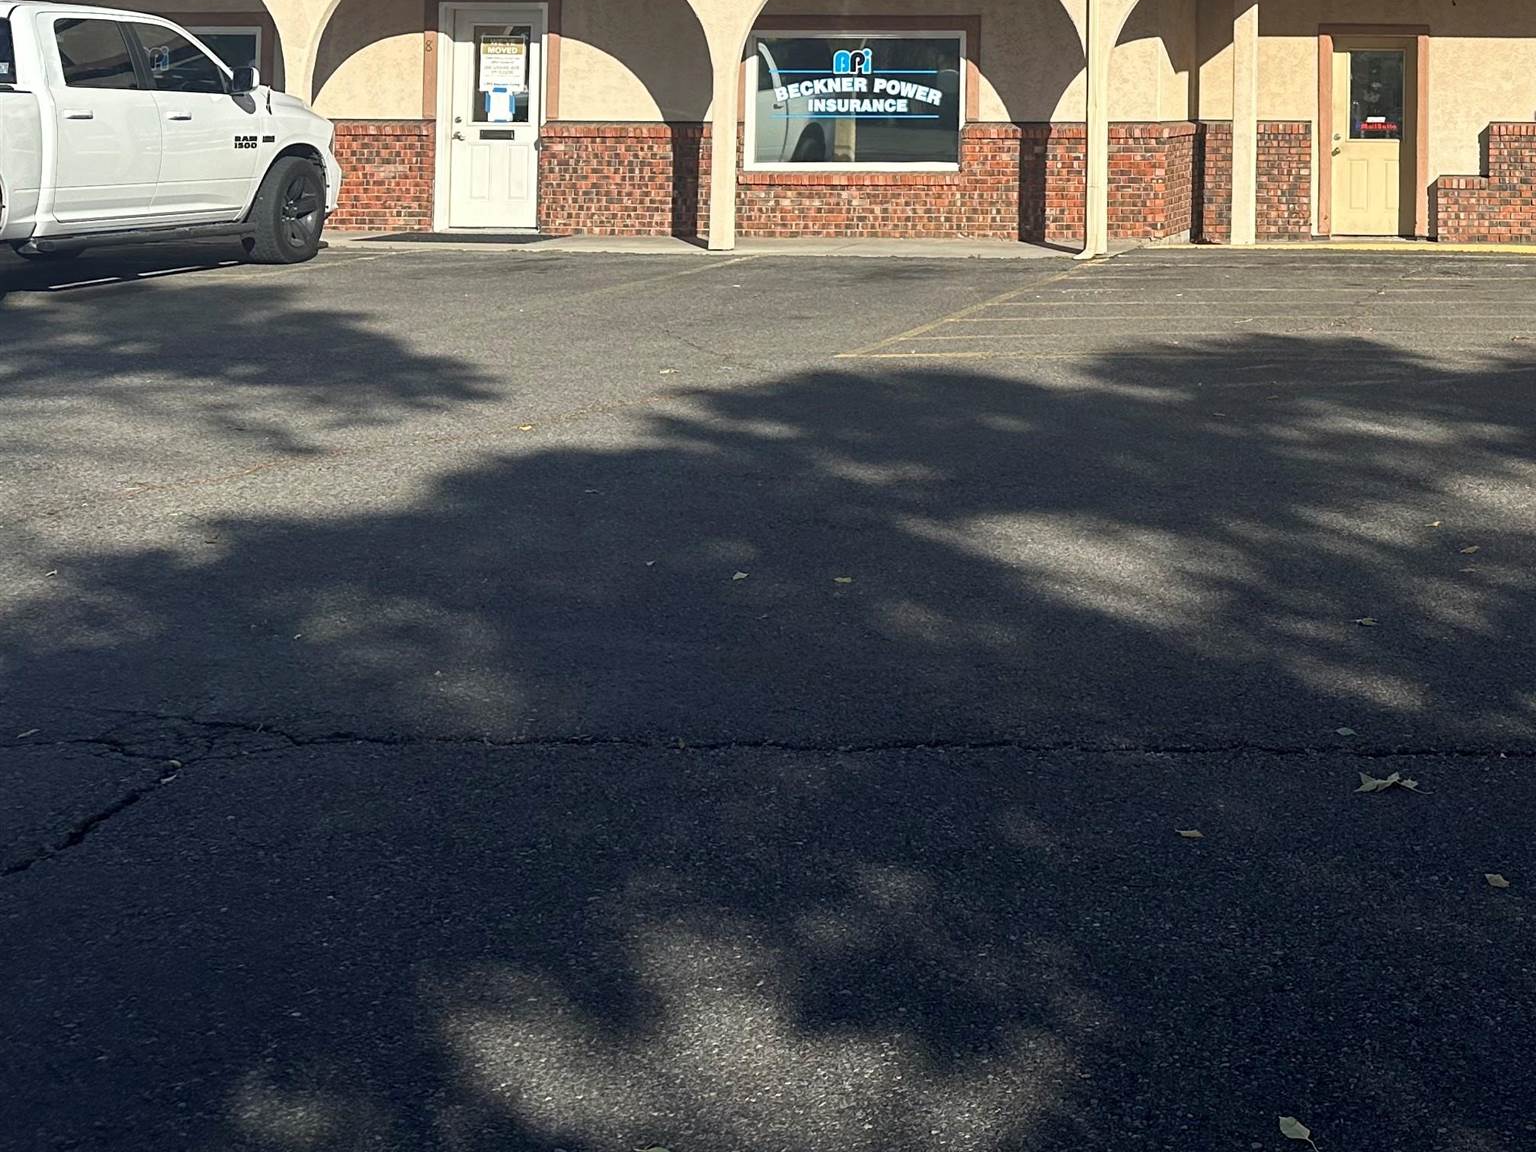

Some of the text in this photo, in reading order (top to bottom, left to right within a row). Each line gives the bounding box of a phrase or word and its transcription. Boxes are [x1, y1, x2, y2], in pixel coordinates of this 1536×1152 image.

[487, 46, 518, 55] MOVED
[774, 77, 943, 106] BECKNER POWER
[808, 98, 908, 113] INSURANCE
